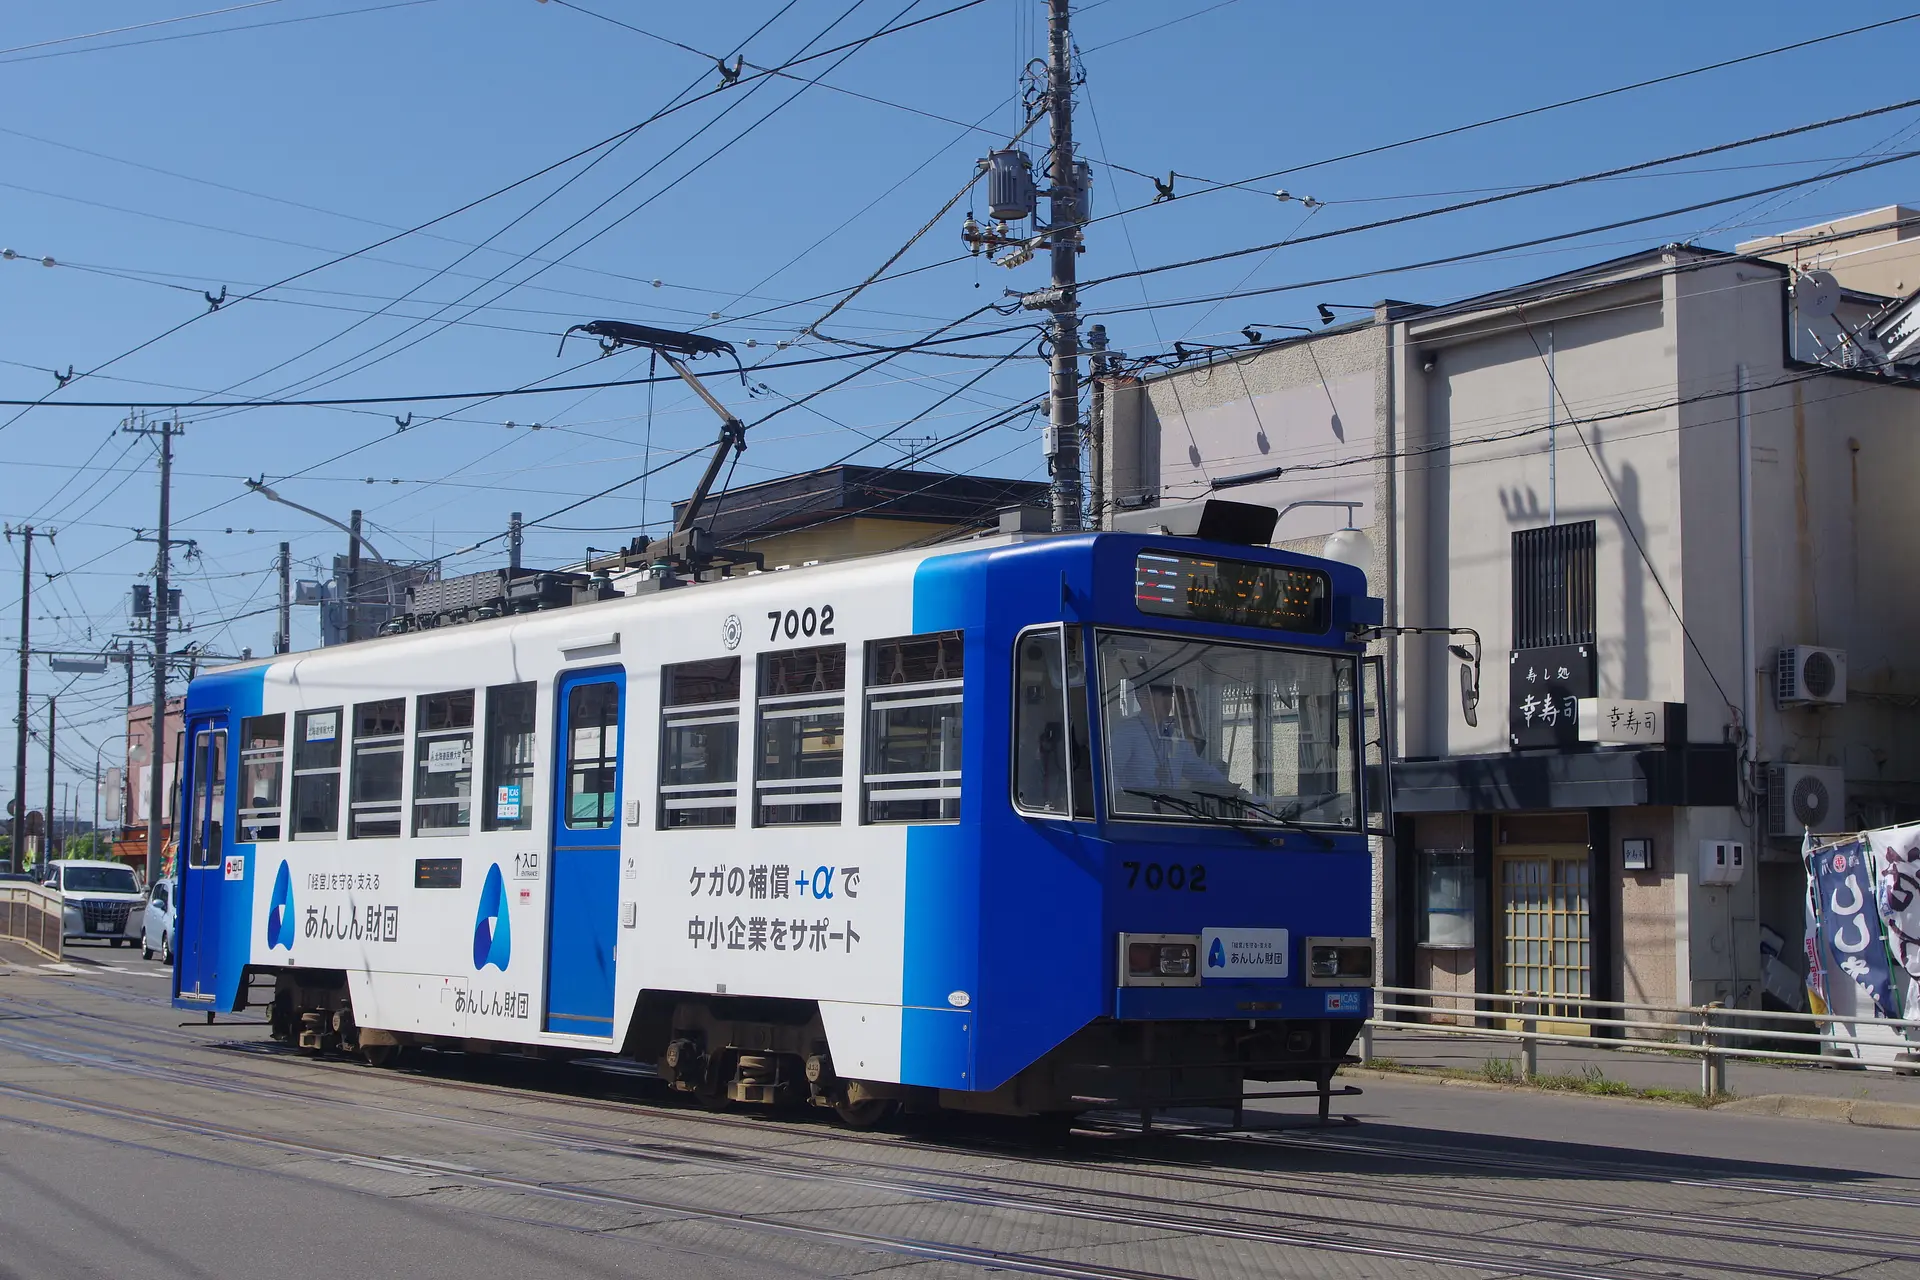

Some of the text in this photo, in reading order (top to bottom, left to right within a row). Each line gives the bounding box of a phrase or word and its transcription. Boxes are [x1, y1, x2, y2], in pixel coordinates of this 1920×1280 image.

[767, 604, 835, 642] 7002
[1525, 666, 1571, 683] 寿し処
[1519, 693, 1578, 728] 幸寿司
[1607, 706, 1656, 735] 幸寿司
[522, 853, 538, 868] 入口
[1122, 861, 1208, 893] 7002
[305, 903, 399, 942] あんしん財団
[688, 914, 861, 954] 中小企業をサポート
[1230, 952, 1283, 965] あんしん財団
[455, 988, 529, 1020] あんしん財団
[1340, 994, 1358, 1003] ICAS
